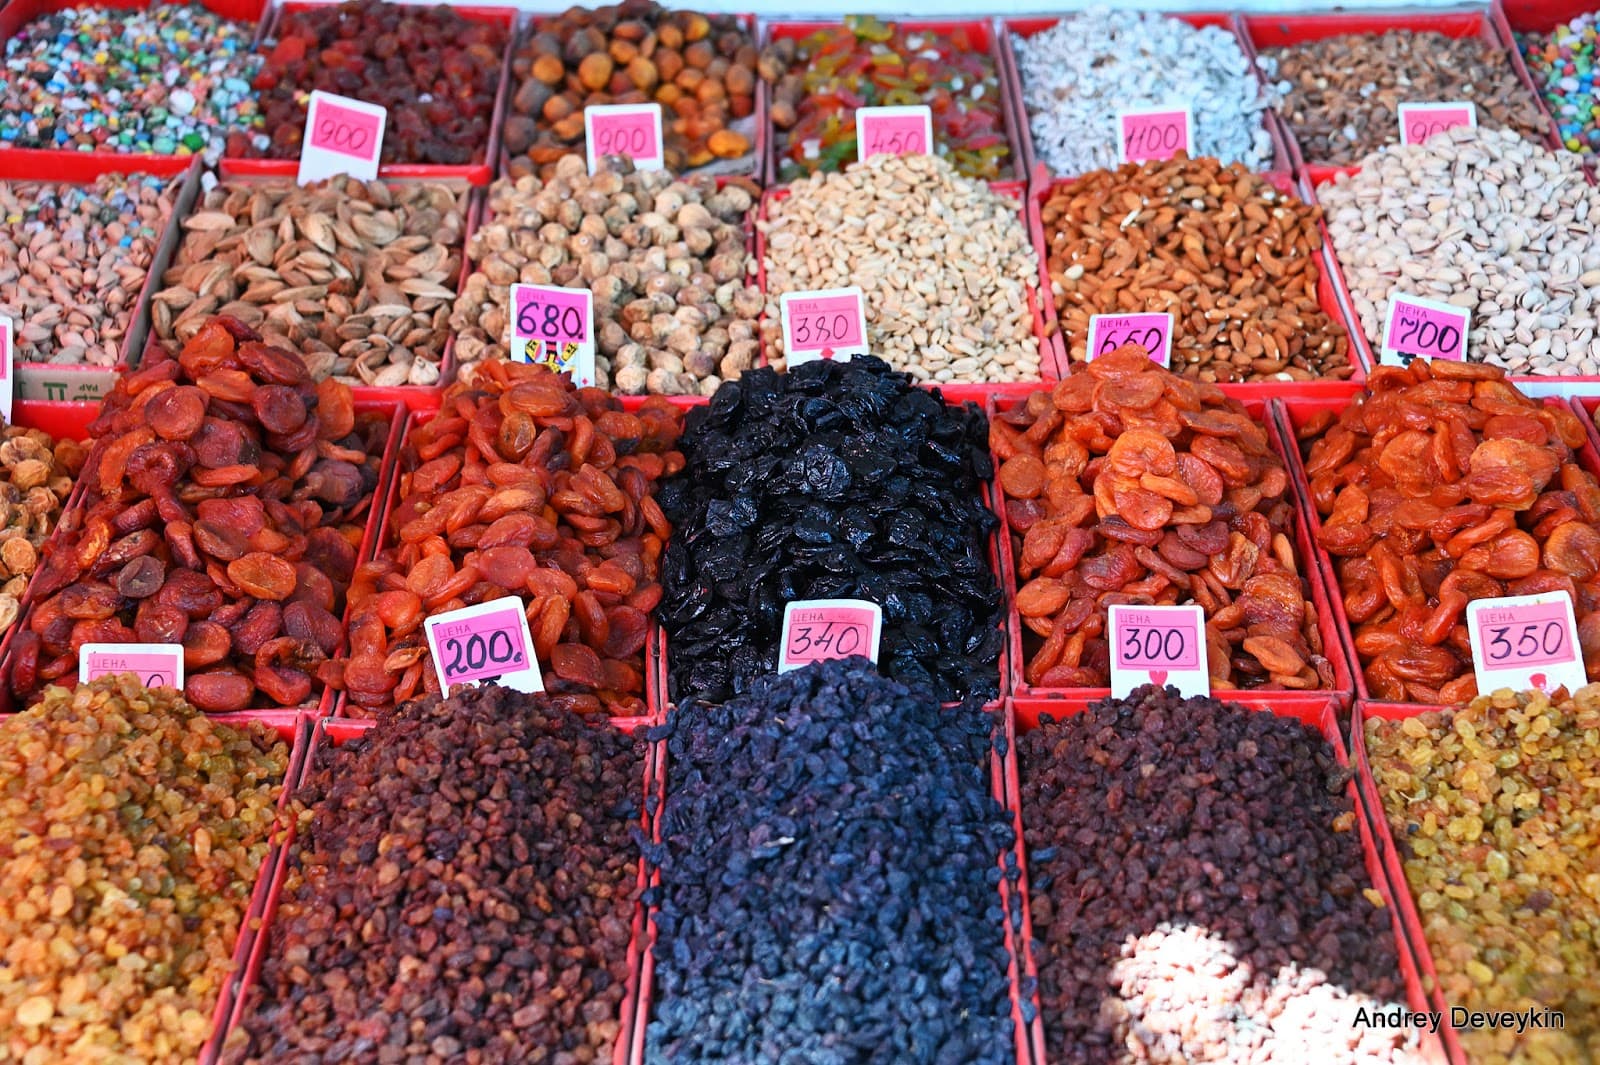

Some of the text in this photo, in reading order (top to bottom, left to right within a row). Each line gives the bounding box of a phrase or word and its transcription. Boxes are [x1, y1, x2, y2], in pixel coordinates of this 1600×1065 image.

[321, 119, 368, 150] 900
[599, 128, 647, 156] 900
[871, 128, 921, 155] 450
[1125, 124, 1179, 156] 1100
[1100, 319, 1131, 328] ЦЕНА
[1398, 304, 1428, 318] ЦЕНА
[796, 314, 849, 343] 380
[1400, 316, 1460, 353] 700
[792, 612, 825, 622] ЦЕНА
[1120, 613, 1152, 624] ЦЕНА
[1481, 612, 1515, 624] ЦЕНА
[438, 624, 472, 638] ЦЕНА
[791, 622, 859, 655] 340
[1124, 628, 1185, 661] 300
[1490, 622, 1563, 660] 350
[92, 658, 128, 669] ЦЕНА
